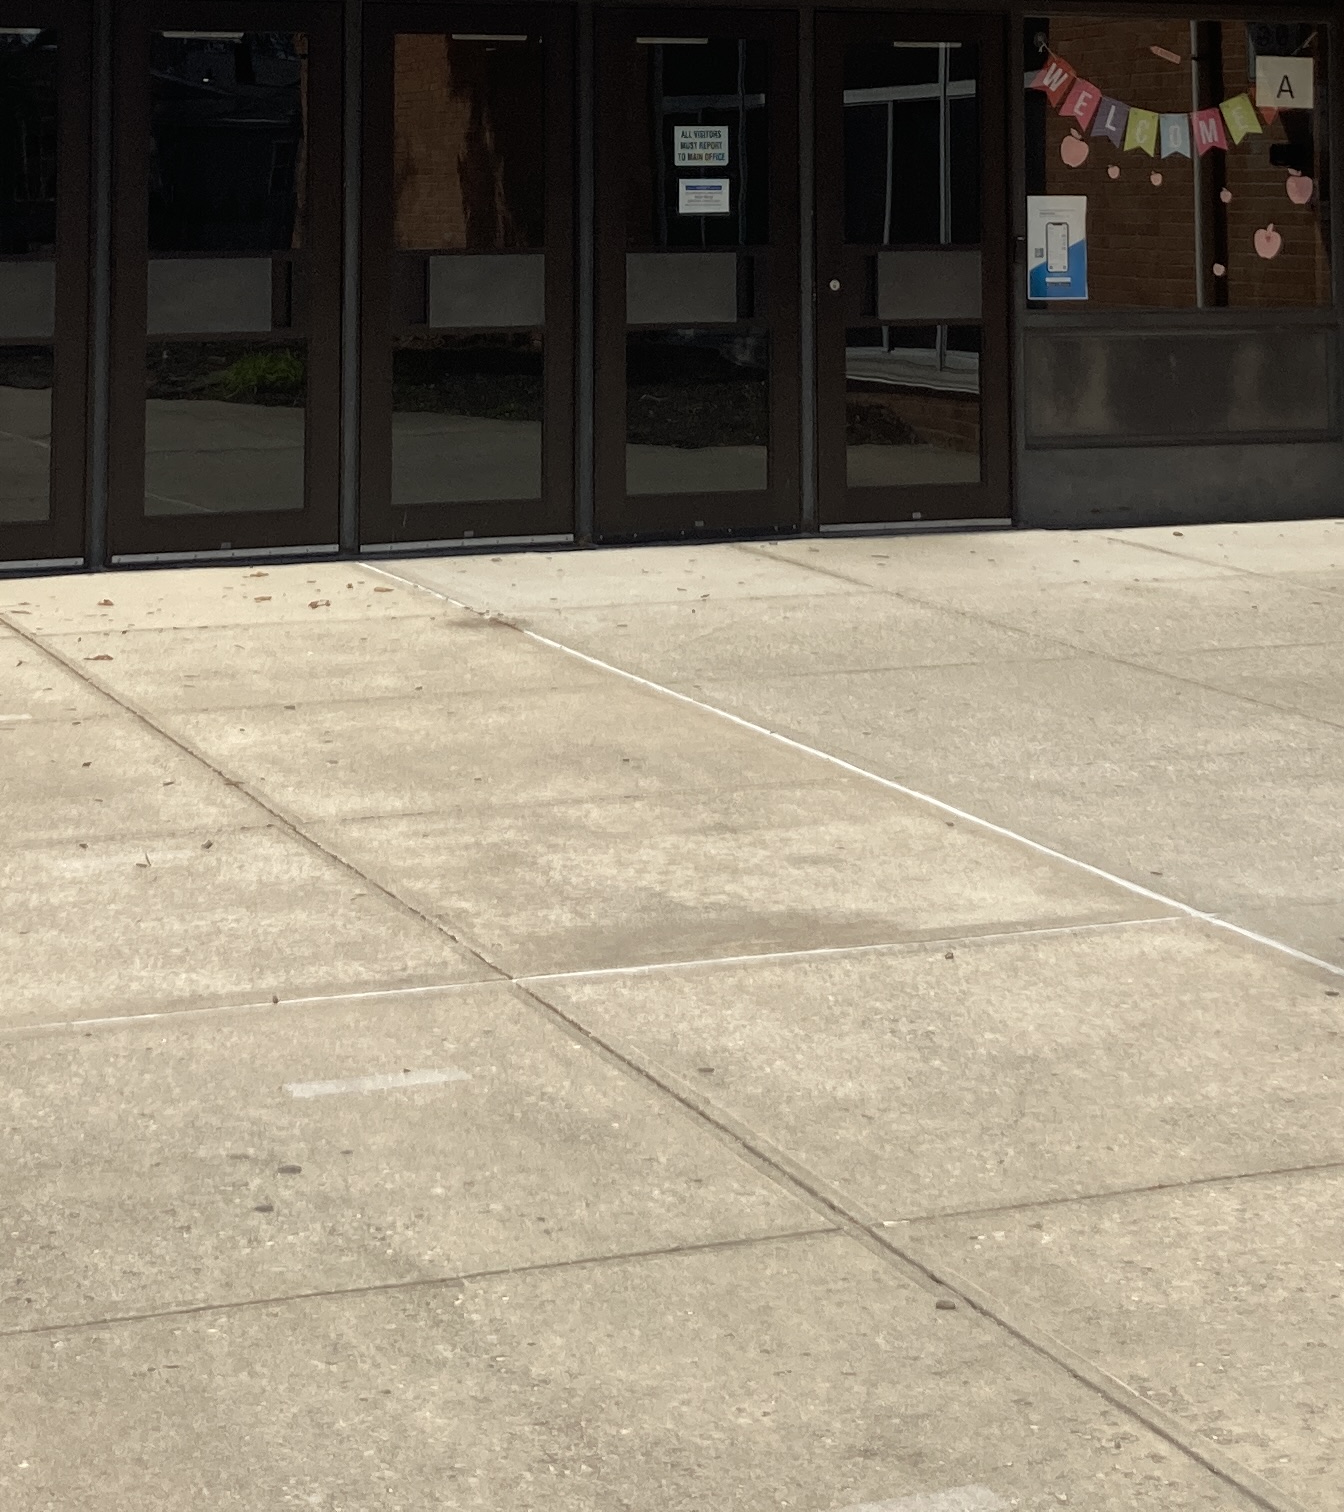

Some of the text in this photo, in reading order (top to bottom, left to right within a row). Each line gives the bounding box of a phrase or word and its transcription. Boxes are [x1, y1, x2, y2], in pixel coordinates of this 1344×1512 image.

[1276, 74, 1295, 99] A
[1042, 62, 1249, 149] WELCOME
[681, 130, 722, 138] ALL VISITORS
[680, 141, 723, 150] MUST REPORT
[677, 152, 725, 161] TO MAIN OFFICE
